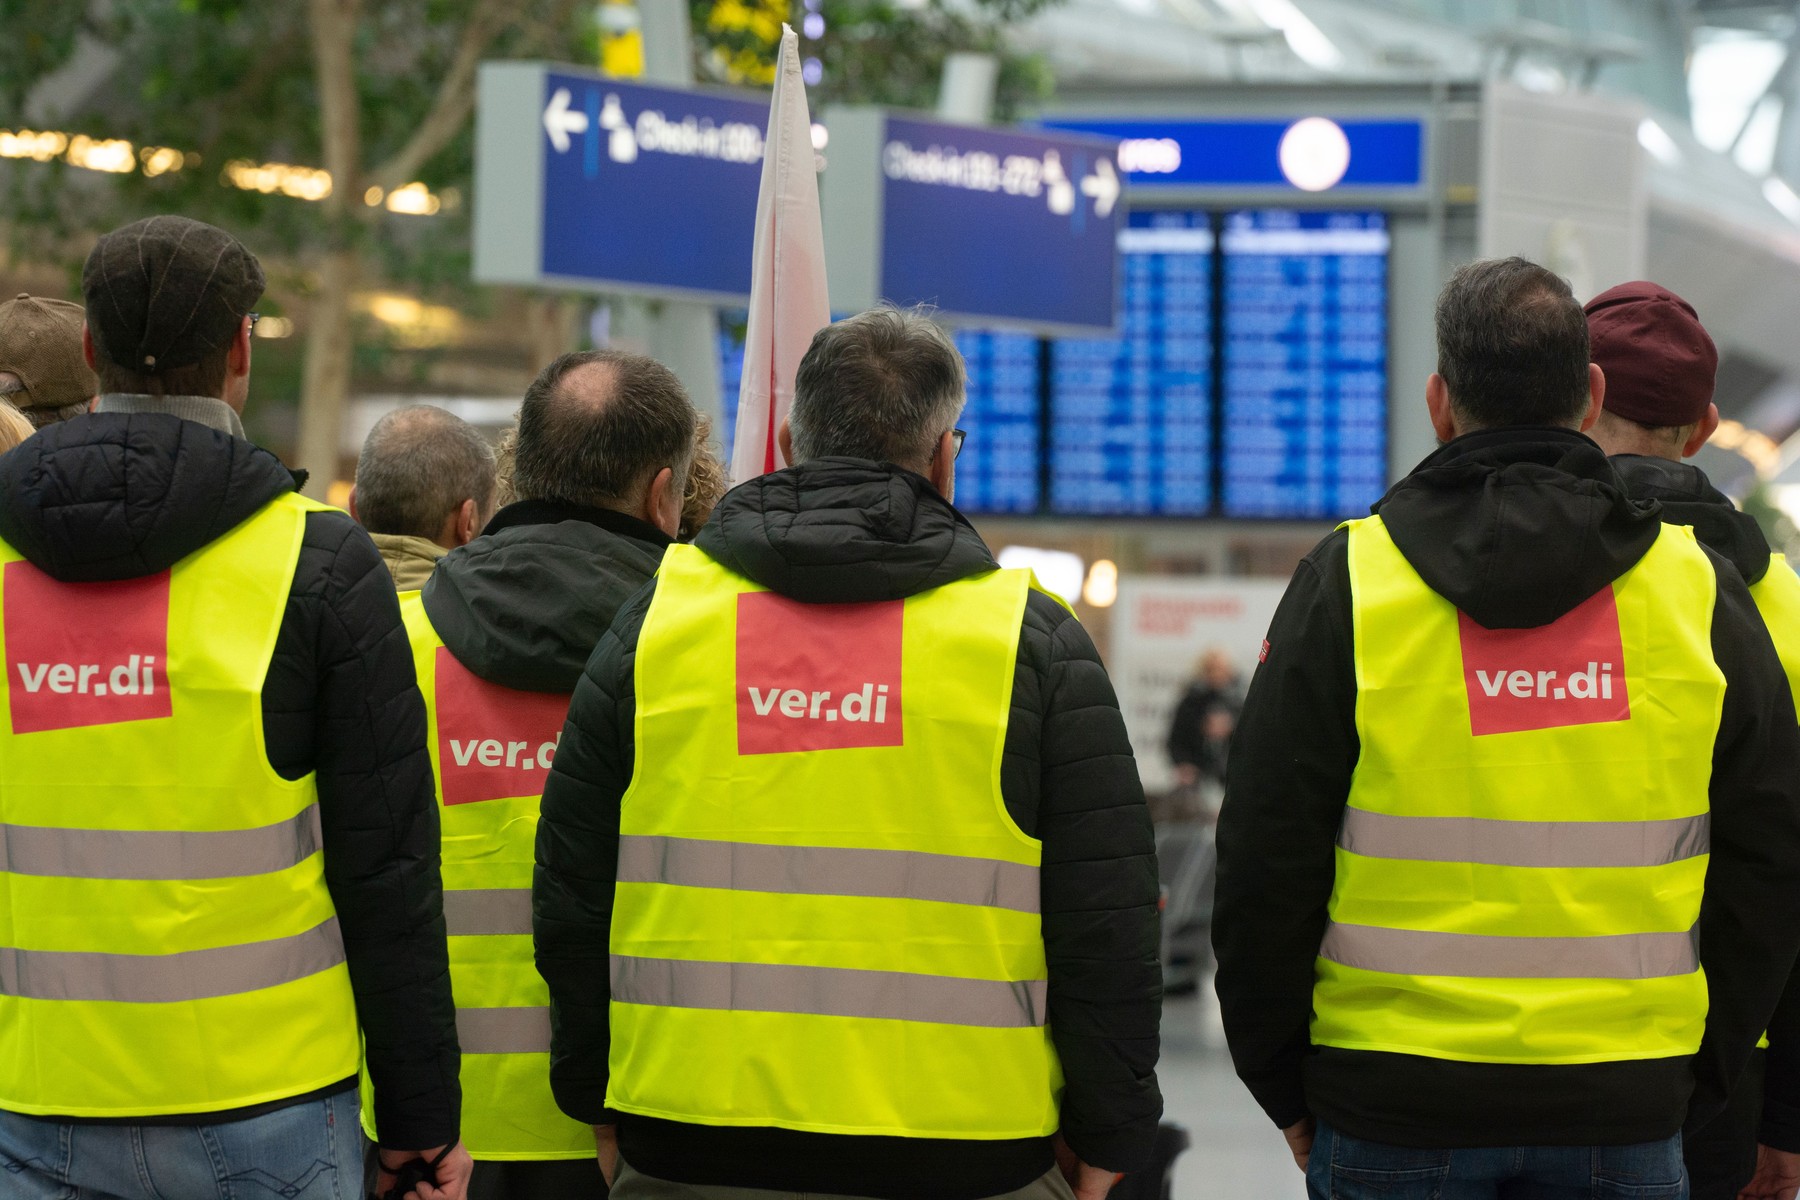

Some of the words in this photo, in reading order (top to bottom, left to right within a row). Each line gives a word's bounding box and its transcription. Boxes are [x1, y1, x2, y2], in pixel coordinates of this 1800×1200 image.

[17, 655, 155, 696] ver.di
[1476, 662, 1612, 700] ver.di
[748, 683, 889, 723] ver.di
[449, 731, 563, 770] ver.d
